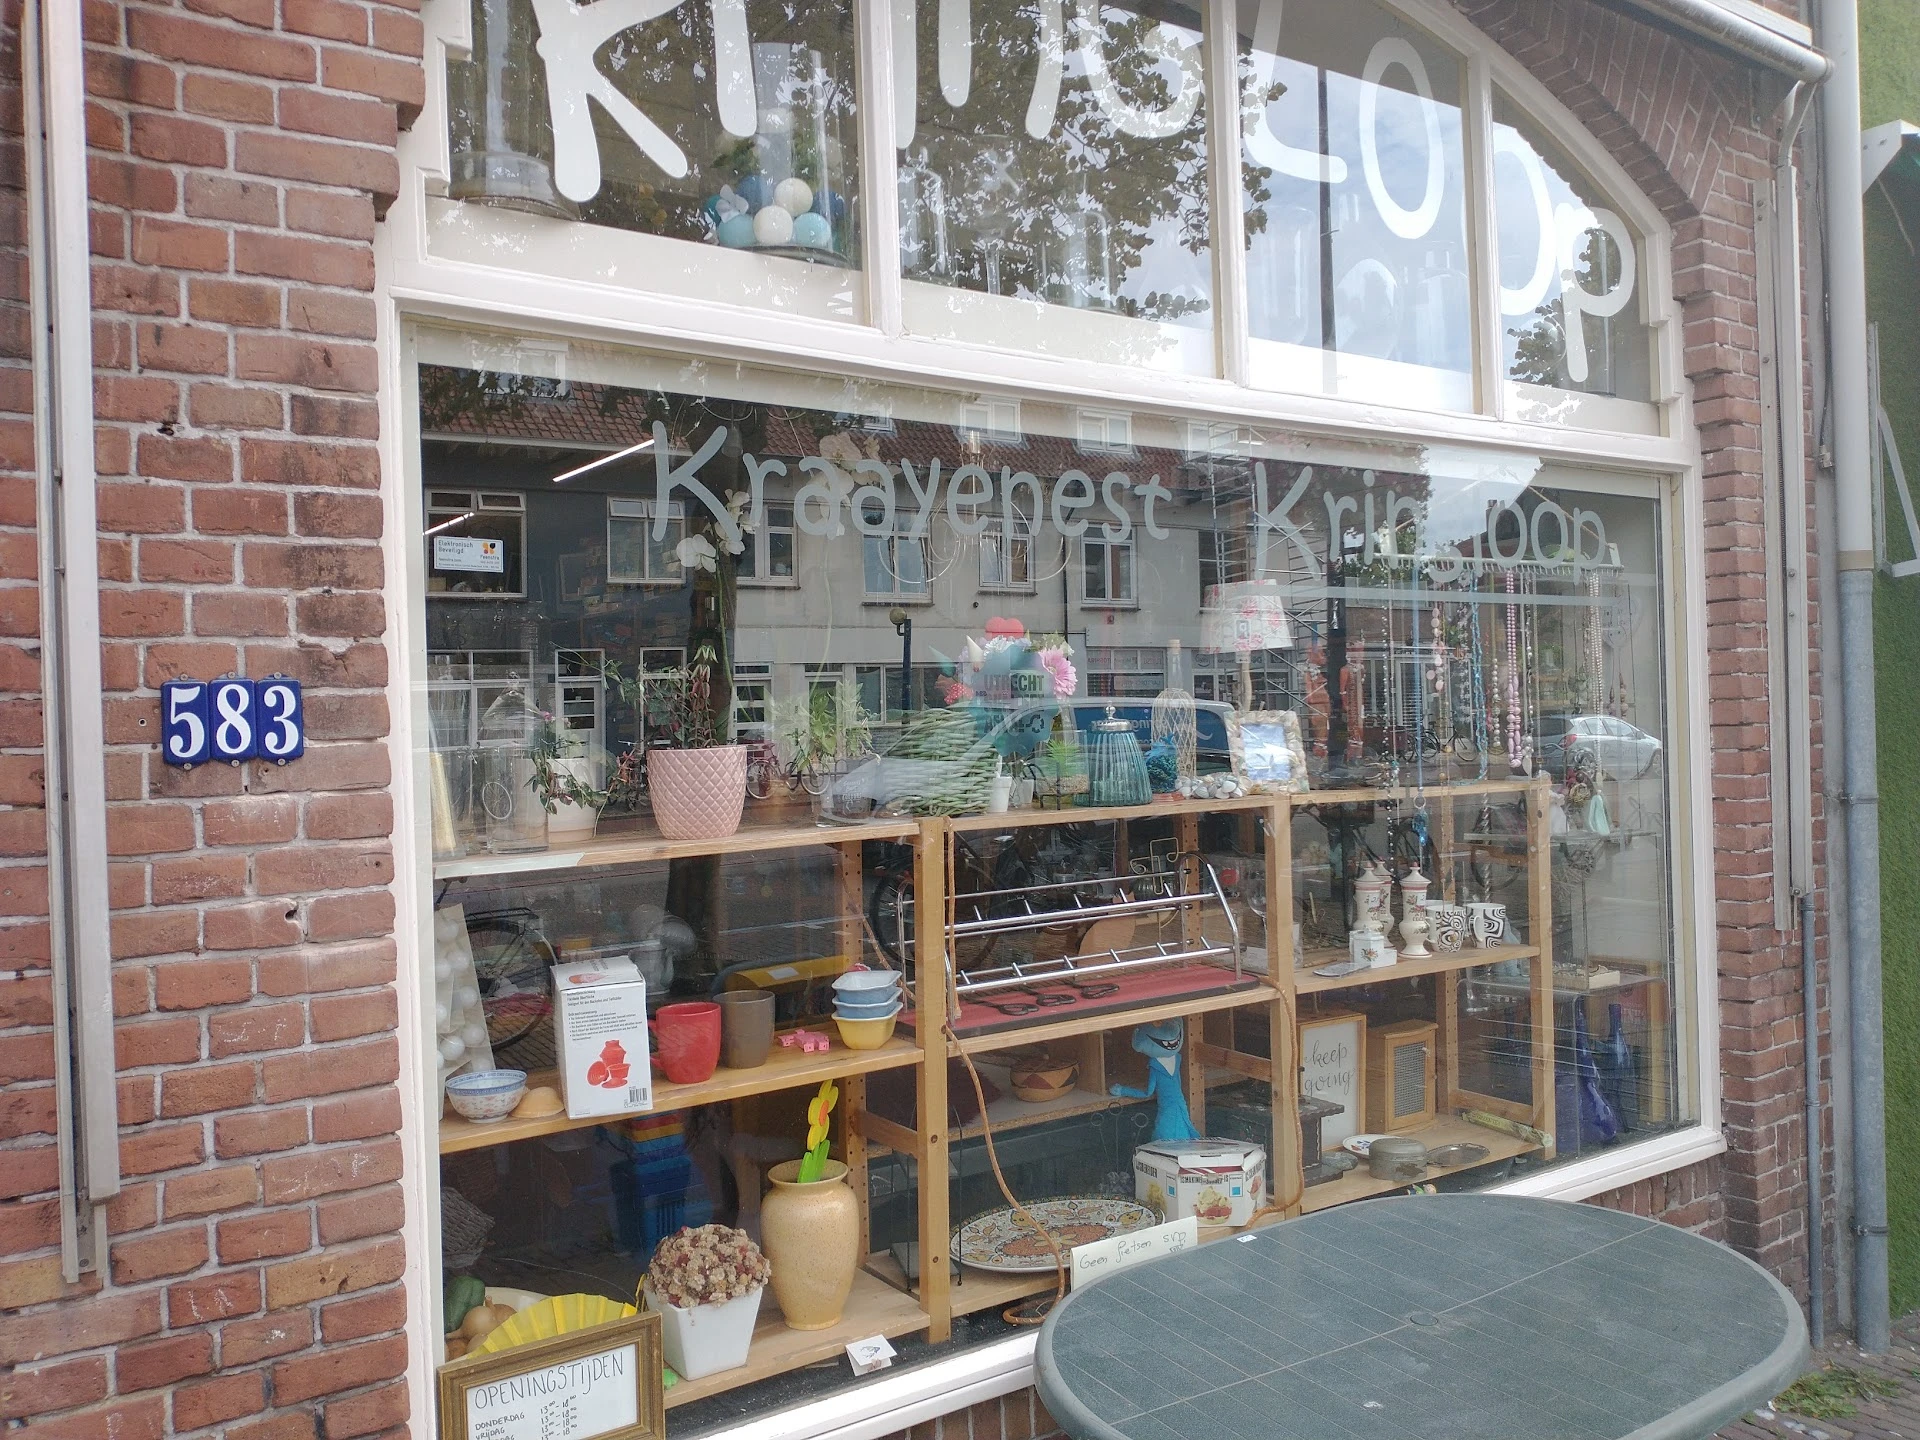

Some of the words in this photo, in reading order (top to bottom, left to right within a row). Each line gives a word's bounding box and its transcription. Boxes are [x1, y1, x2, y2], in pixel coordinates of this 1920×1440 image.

[652, 420, 1172, 545] Kraayenest
[169, 684, 299, 758] 583
[1305, 1039, 1348, 1067] keep
[1304, 1068, 1355, 1096] going
[1079, 1254, 1108, 1270] Geen
[475, 1411, 525, 1430] DONDERDAG
